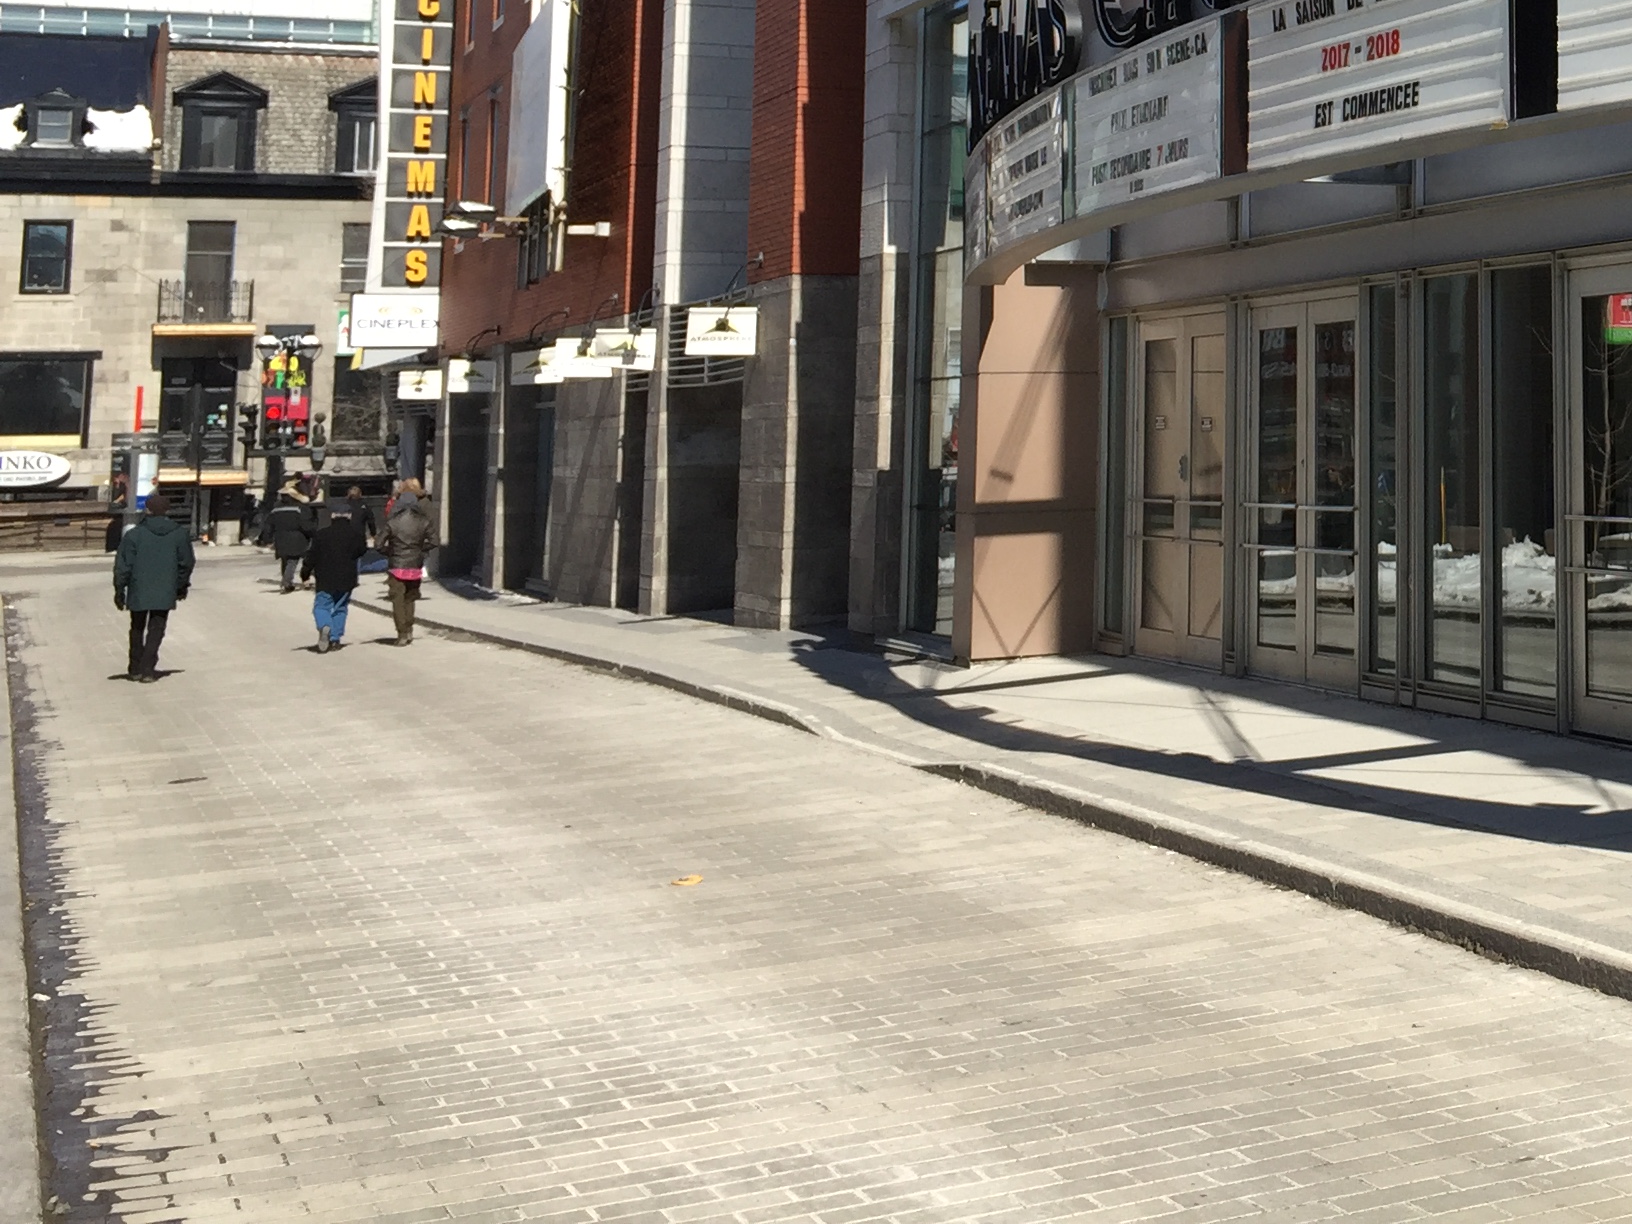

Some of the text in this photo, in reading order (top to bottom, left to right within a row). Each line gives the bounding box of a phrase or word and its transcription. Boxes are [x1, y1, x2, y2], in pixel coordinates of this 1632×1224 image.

[1273, 9, 1286, 32] LA
[1321, 42, 1350, 71] 2017
[1367, 29, 1400, 60] 2018
[1315, 81, 1420, 128] EST COMMENCEE
[1156, 145, 1163, 167] 7
[357, 319, 440, 329] CINEPLEX
